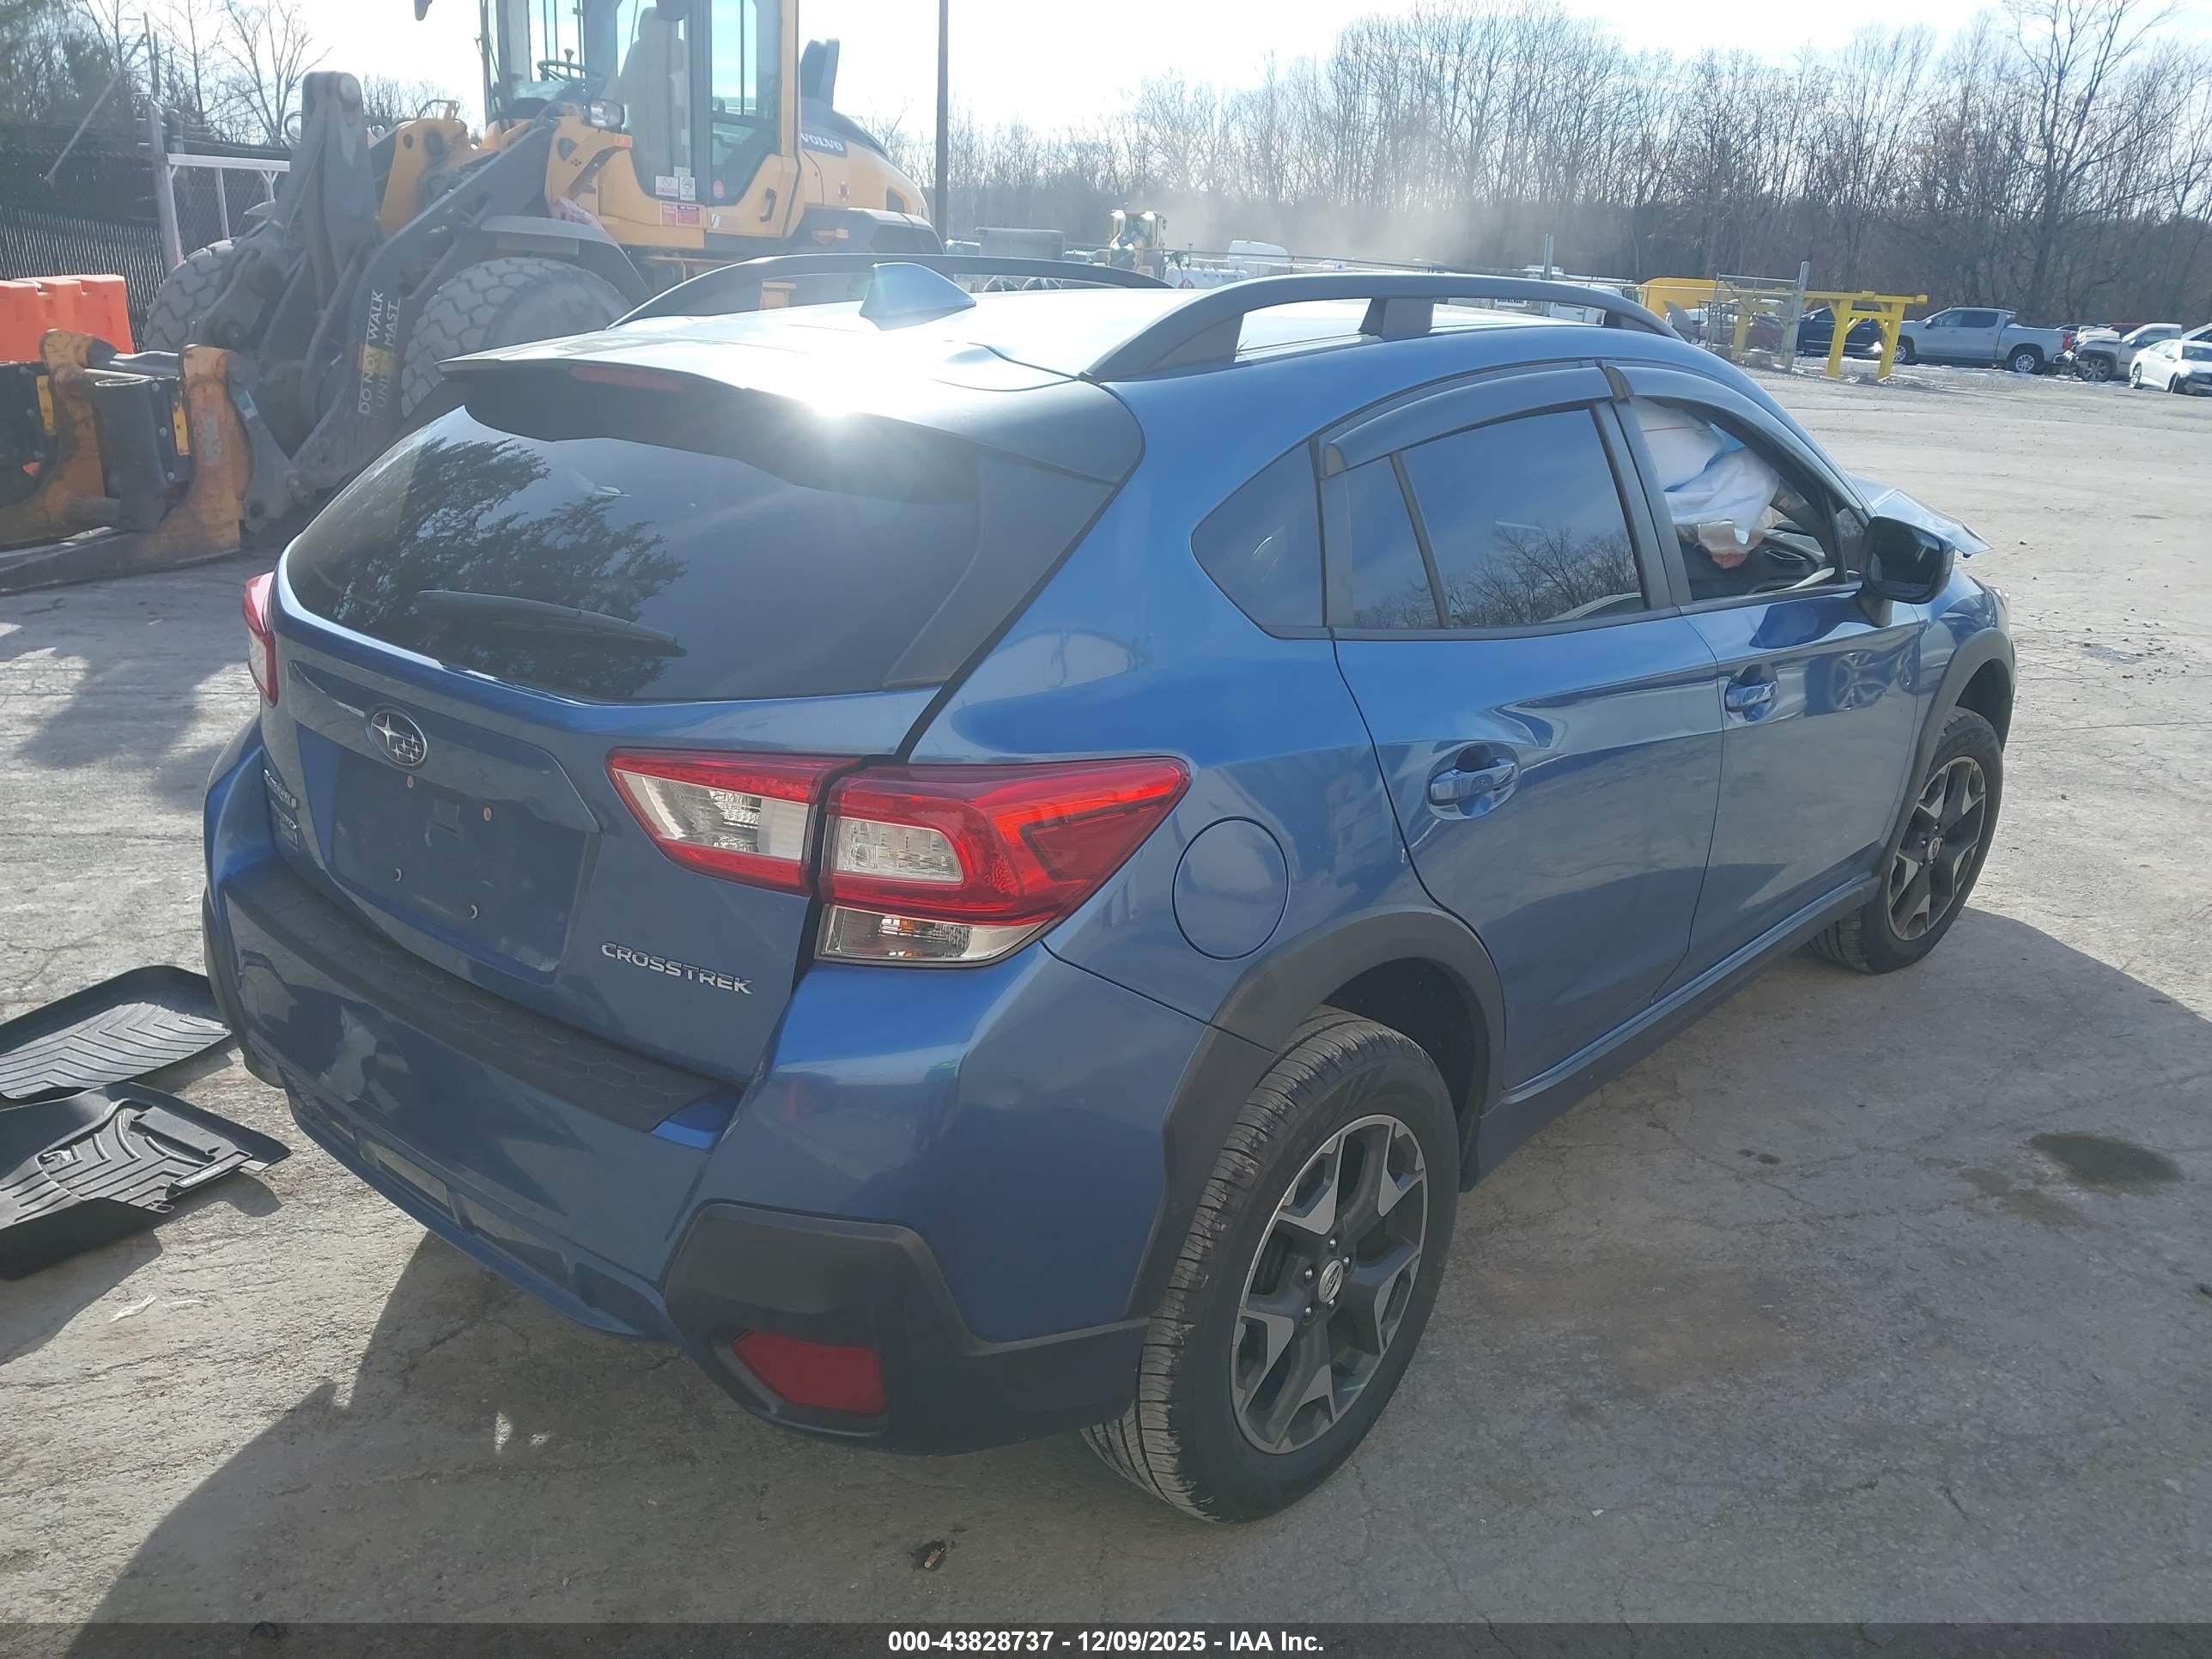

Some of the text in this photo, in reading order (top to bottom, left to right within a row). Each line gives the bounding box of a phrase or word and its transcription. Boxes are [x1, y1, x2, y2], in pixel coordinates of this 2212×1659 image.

[800, 132, 844, 150] VOLVO
[385, 300, 398, 346] MAST
[359, 389, 372, 413] DO
[368, 289, 384, 340] WALK
[601, 942, 753, 995] CROSSTREK
